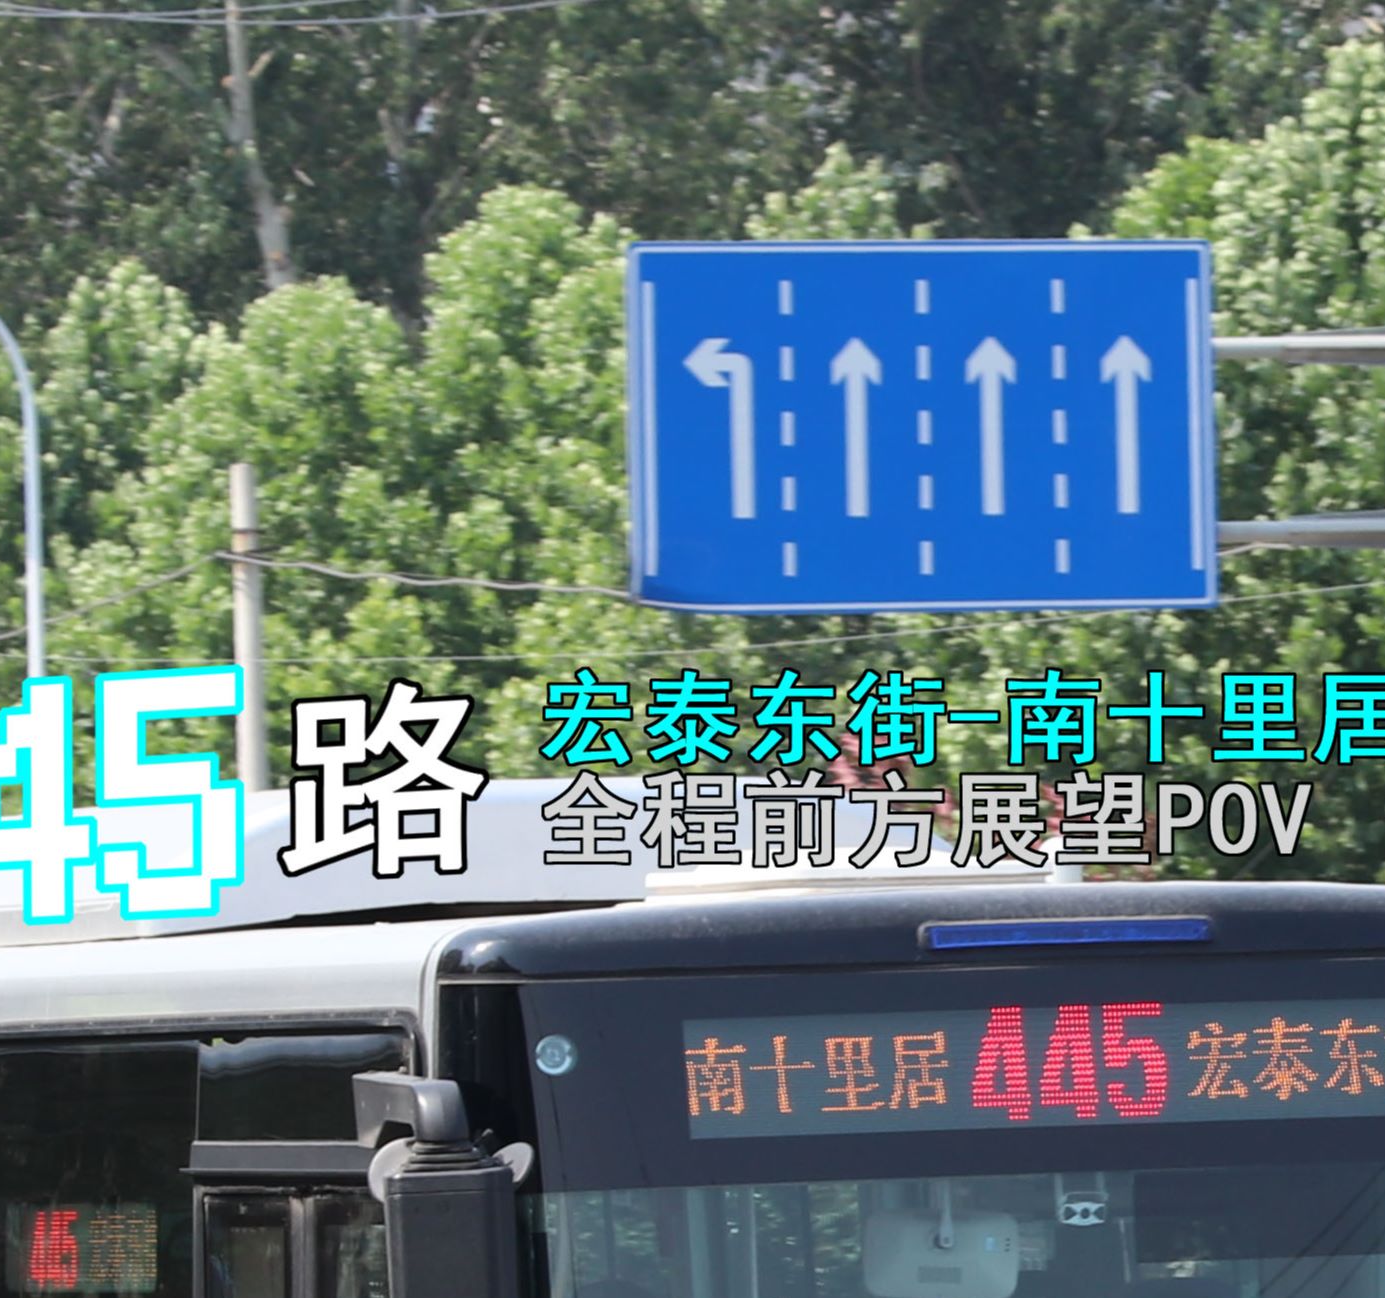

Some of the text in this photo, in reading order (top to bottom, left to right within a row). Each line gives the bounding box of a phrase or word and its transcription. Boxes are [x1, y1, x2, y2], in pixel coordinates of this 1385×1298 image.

[685, 1031, 951, 1118] 南十里居
[971, 1001, 1169, 1121] 445
